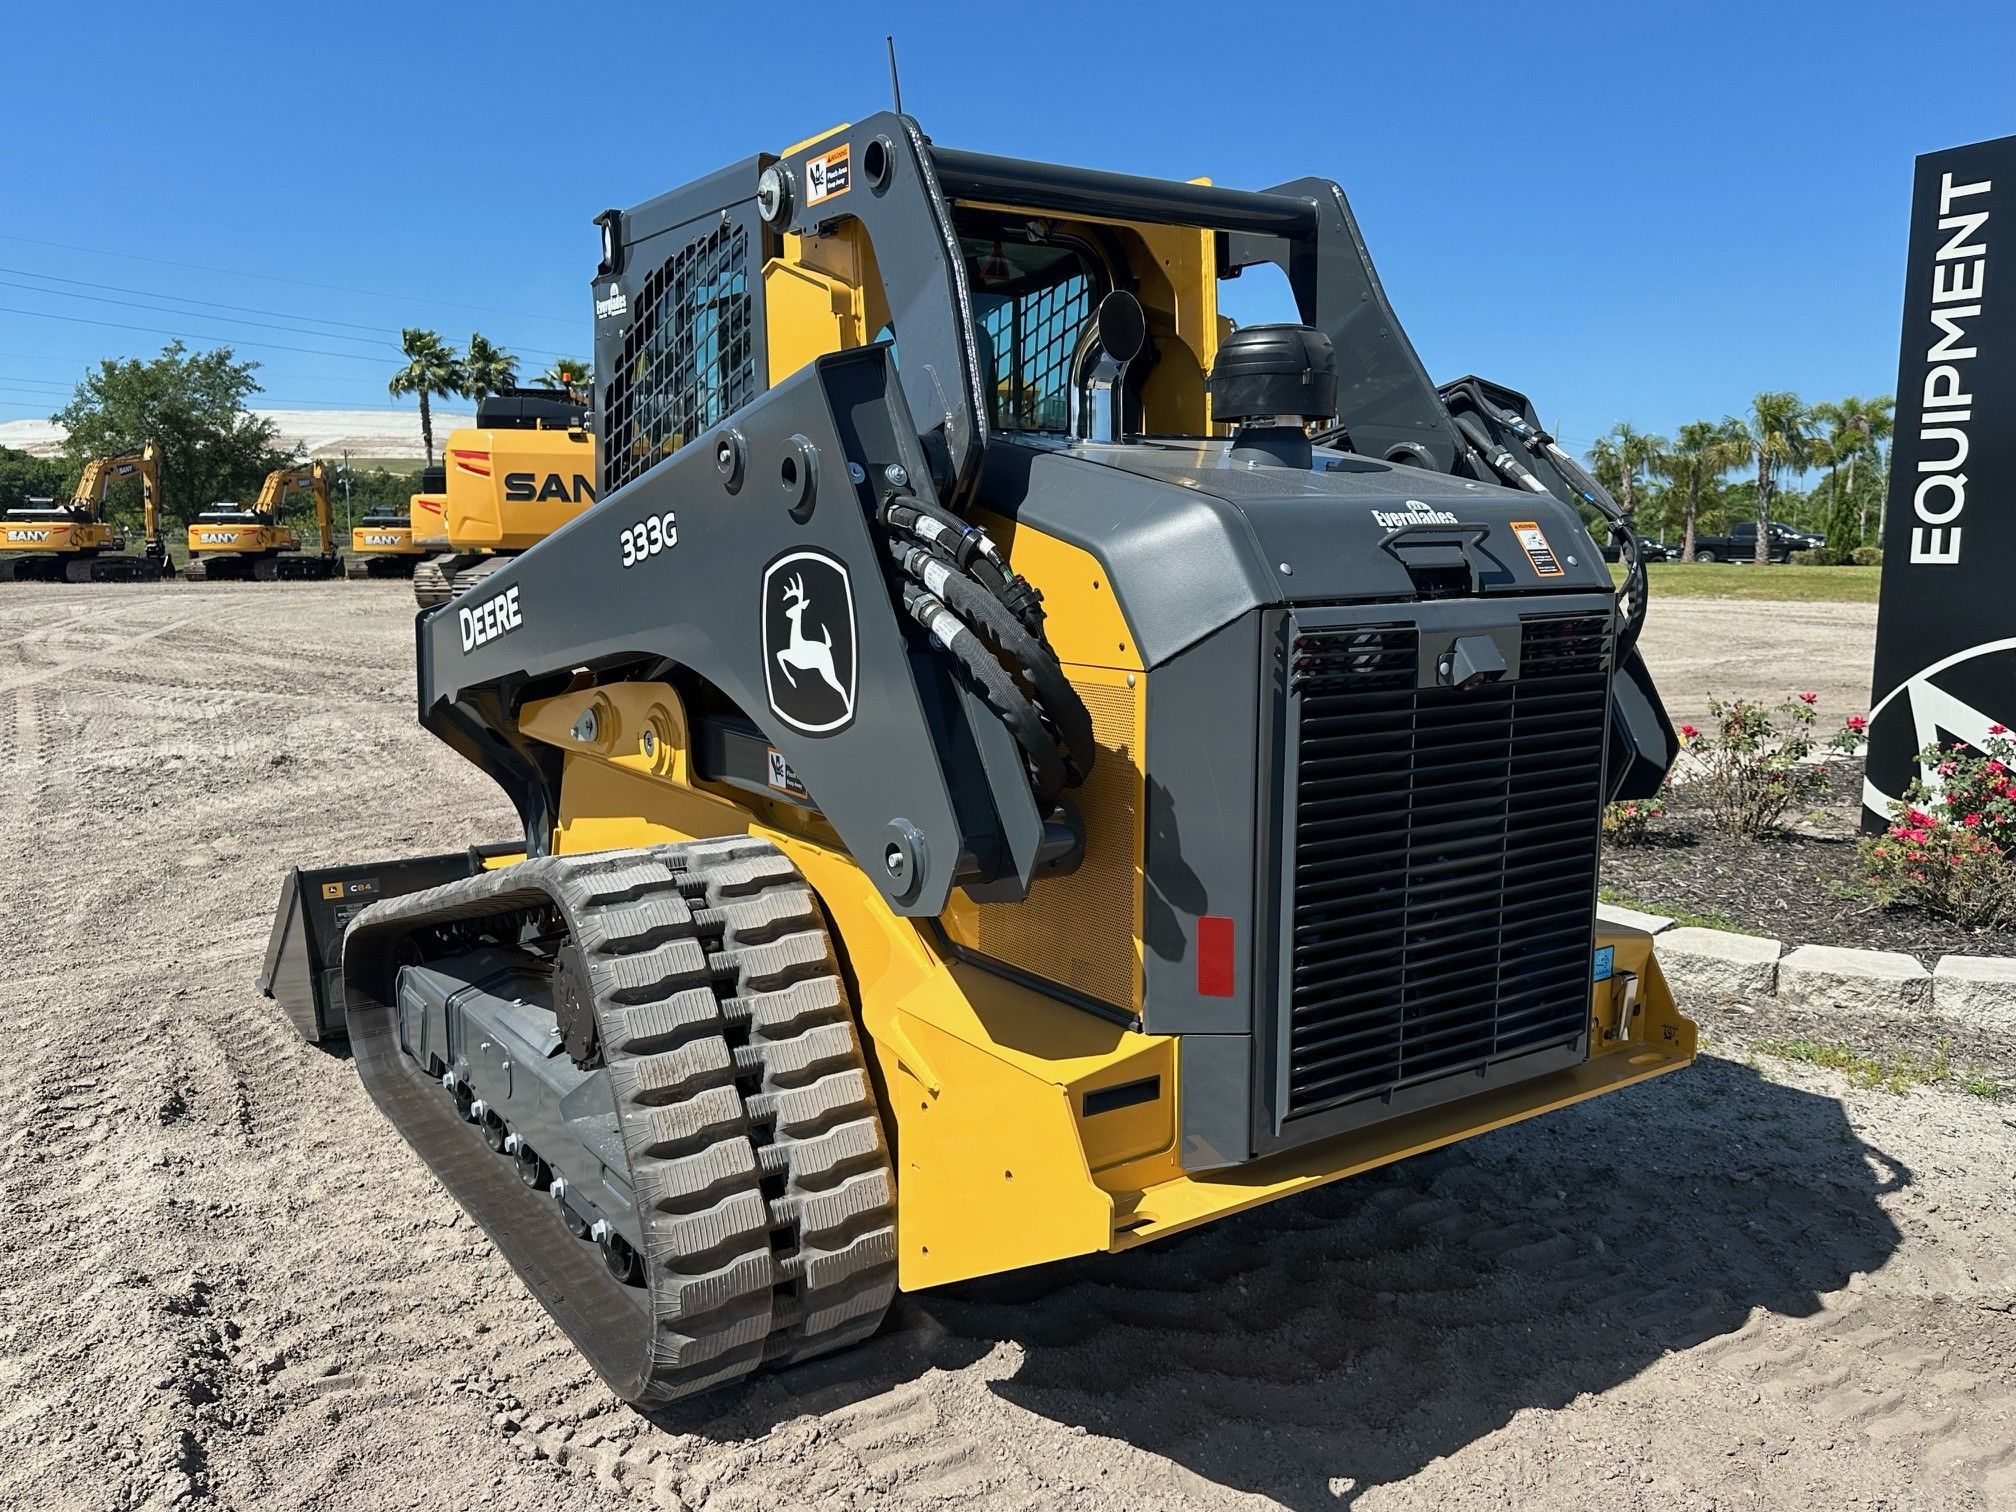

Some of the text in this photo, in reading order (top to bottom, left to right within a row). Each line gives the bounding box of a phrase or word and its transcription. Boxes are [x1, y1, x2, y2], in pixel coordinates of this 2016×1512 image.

[1909, 172, 1992, 566] EQUIPMENT
[504, 472, 596, 503] SAN
[7, 530, 50, 542] SANY
[200, 533, 240, 544] SANY
[364, 535, 402, 545] SANY
[620, 512, 679, 567] 333G
[459, 585, 523, 652] DEERE
[350, 883, 372, 892] C84
